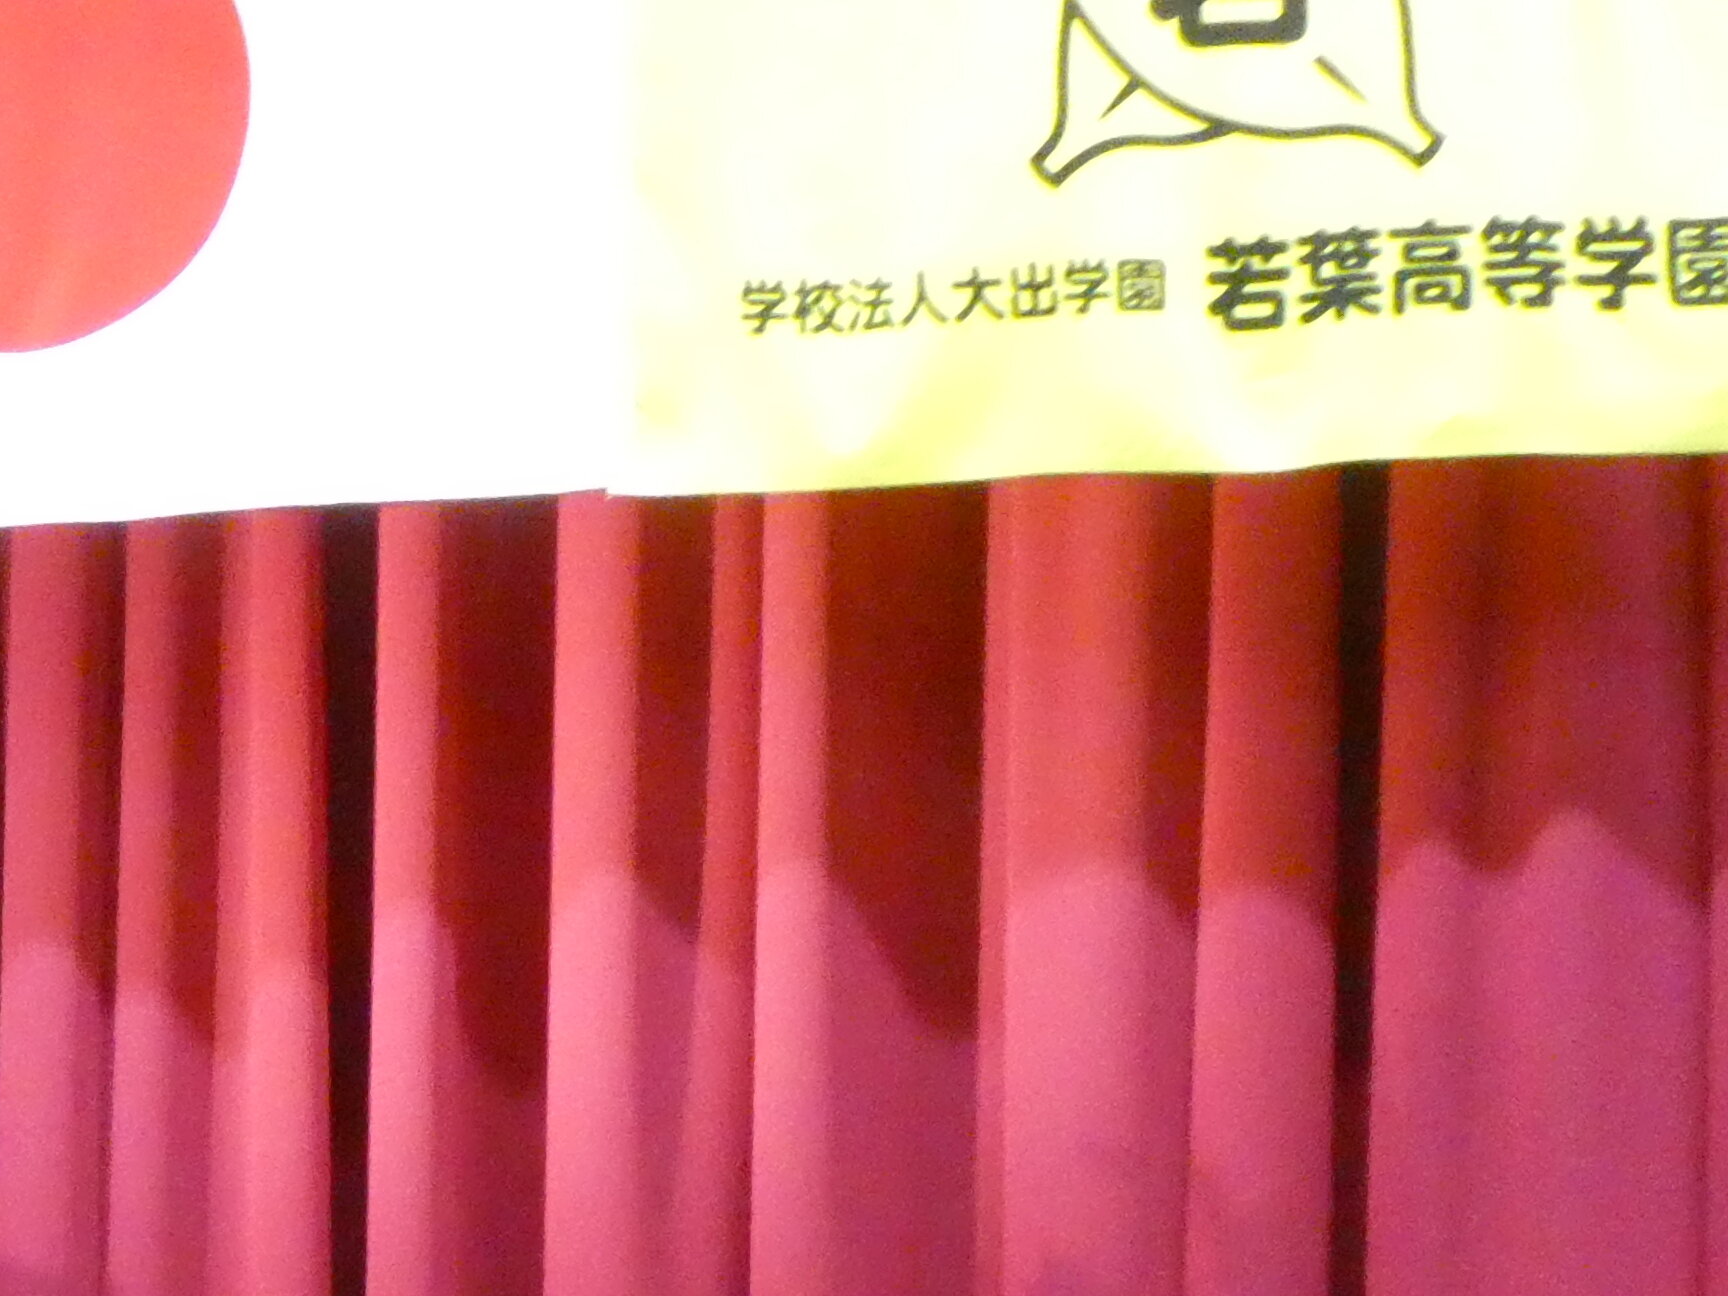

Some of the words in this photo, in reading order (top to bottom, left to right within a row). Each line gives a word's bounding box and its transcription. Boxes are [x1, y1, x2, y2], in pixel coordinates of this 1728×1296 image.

[741, 257, 1166, 335] 学校法人大出学園
[1207, 214, 1728, 332] 若葉高等学園
